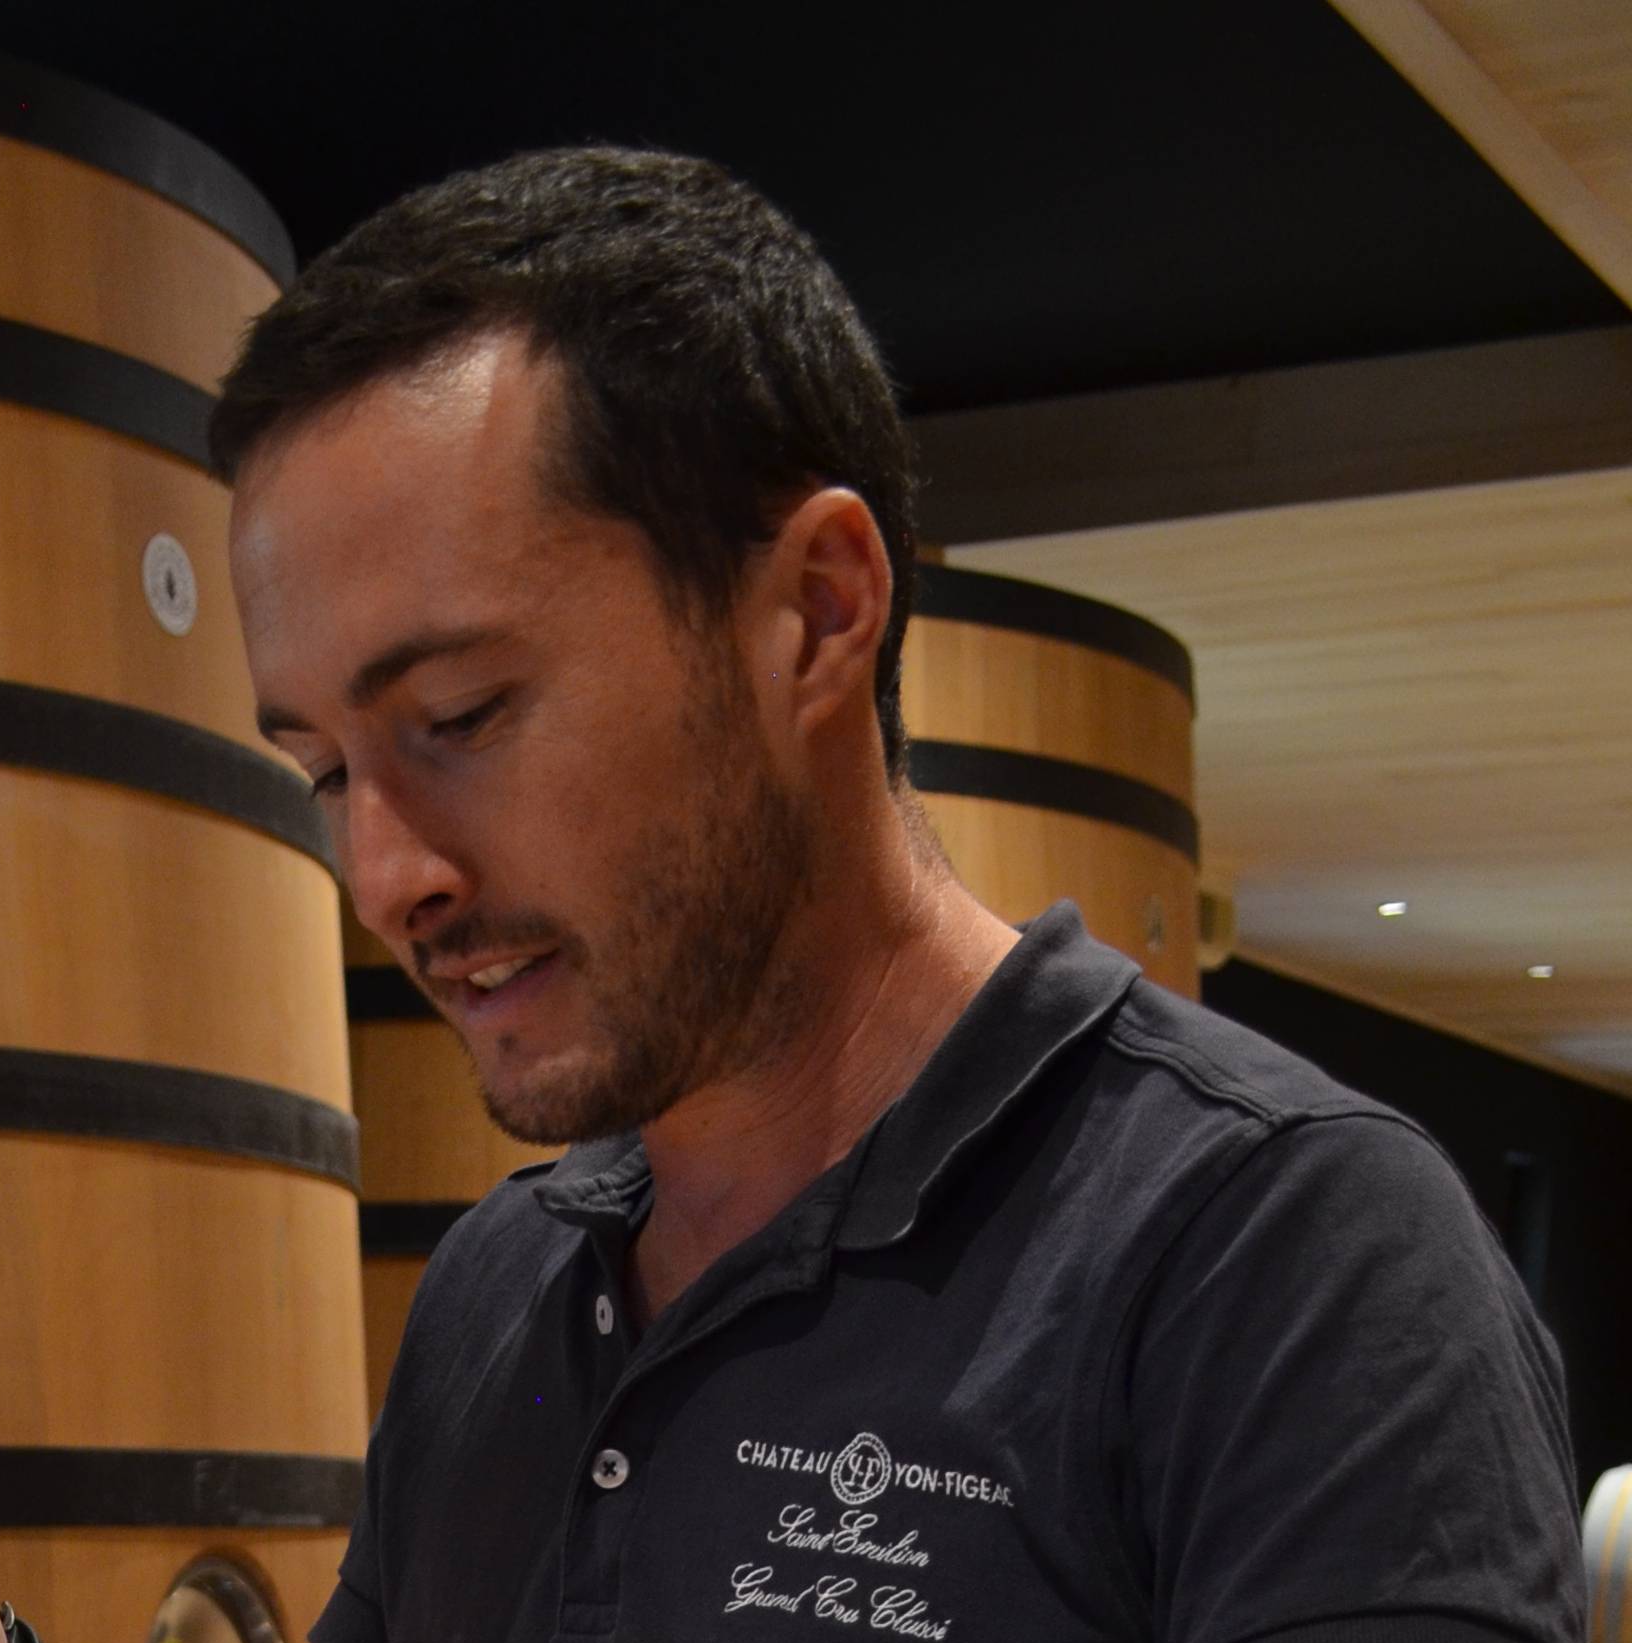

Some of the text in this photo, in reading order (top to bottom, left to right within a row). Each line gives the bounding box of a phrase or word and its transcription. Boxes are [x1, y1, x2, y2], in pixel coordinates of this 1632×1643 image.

[736, 1439, 833, 1475] CHATEAU
[768, 1504, 930, 1567] Saint Emilion
[724, 1563, 814, 1613] Grand
[815, 1575, 859, 1624] Cru
